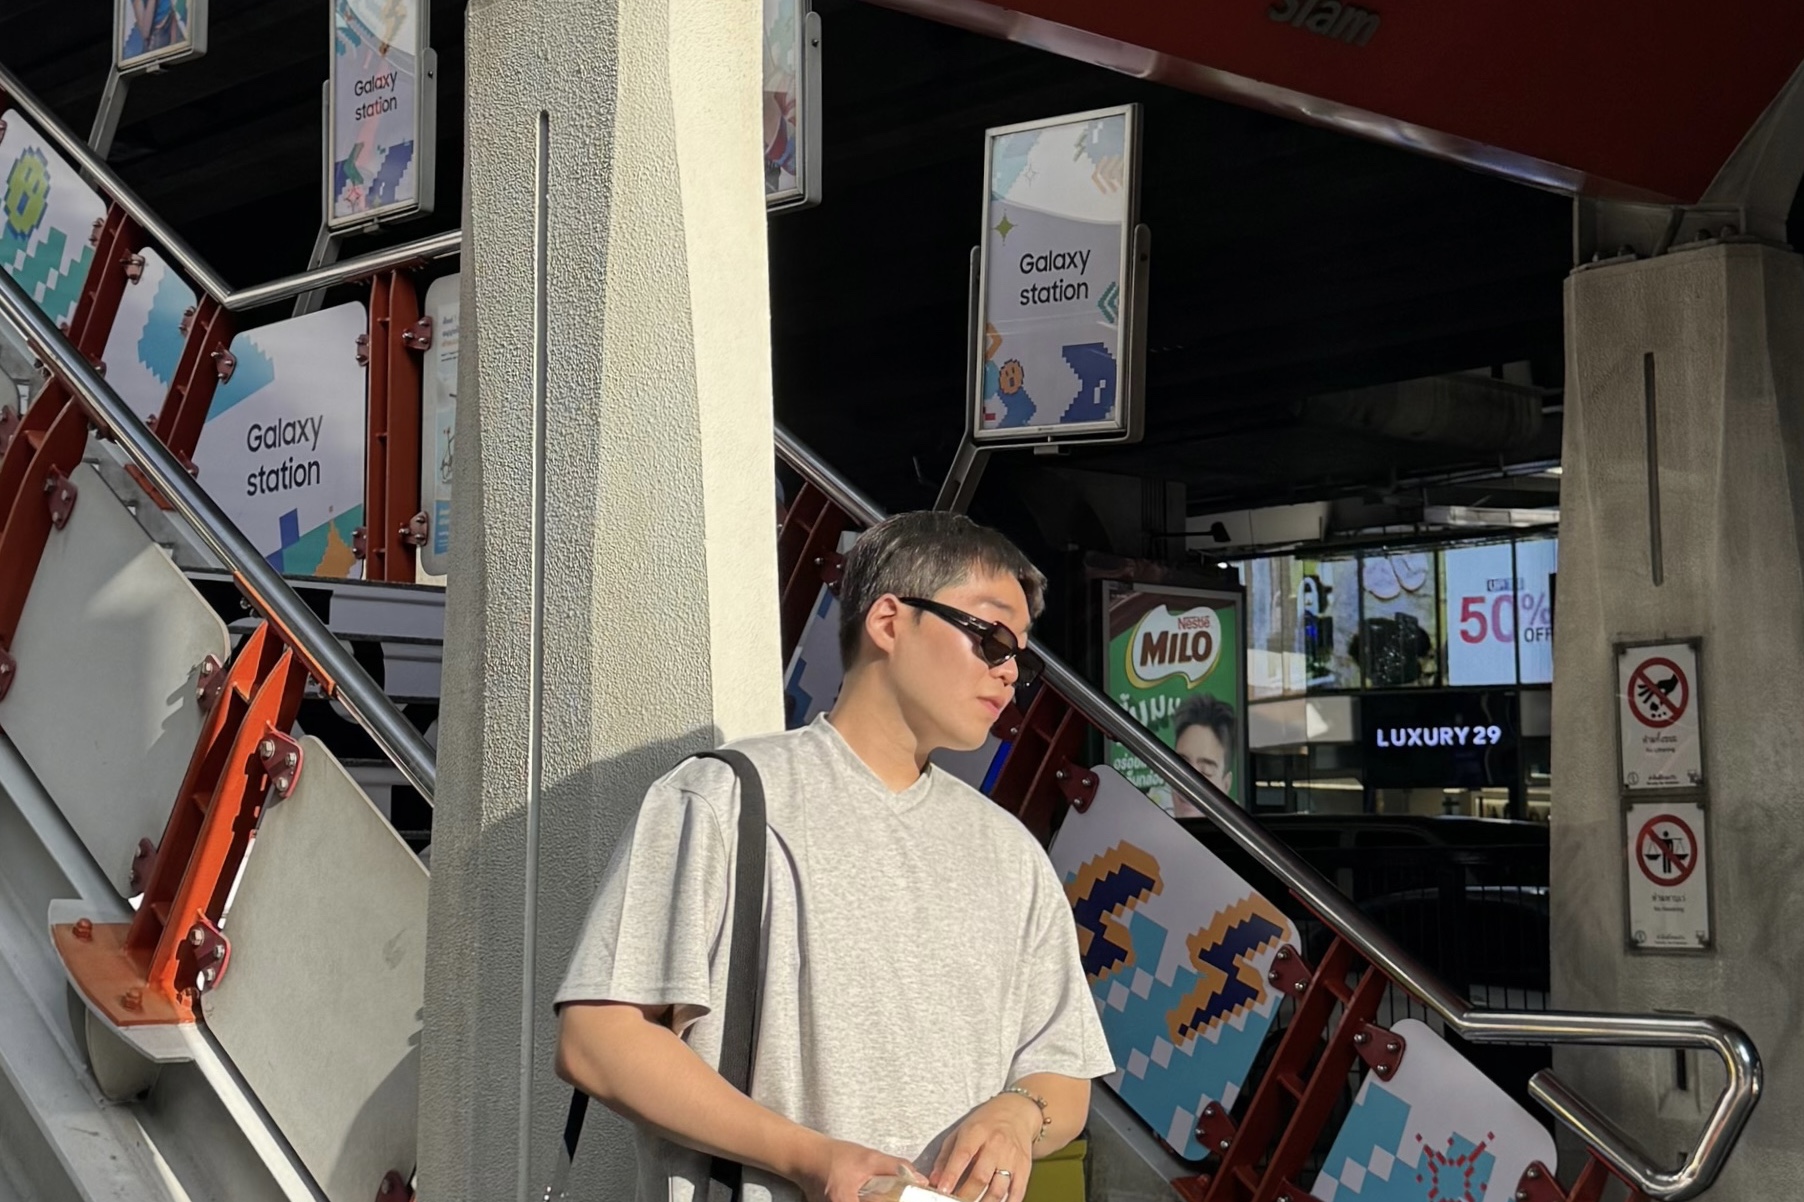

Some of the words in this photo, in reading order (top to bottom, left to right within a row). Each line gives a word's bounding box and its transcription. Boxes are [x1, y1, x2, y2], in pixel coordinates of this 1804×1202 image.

[354, 71, 398, 97] Galaxy
[355, 96, 398, 121] station
[1019, 249, 1091, 275] Galaxy
[1020, 278, 1089, 306] station
[246, 415, 323, 453] Galaxy
[246, 456, 321, 496] station
[1524, 627, 1552, 643] OFF
[1140, 630, 1213, 667] MILO
[1376, 726, 1470, 747] LUXURY
[1473, 725, 1502, 745] 29
